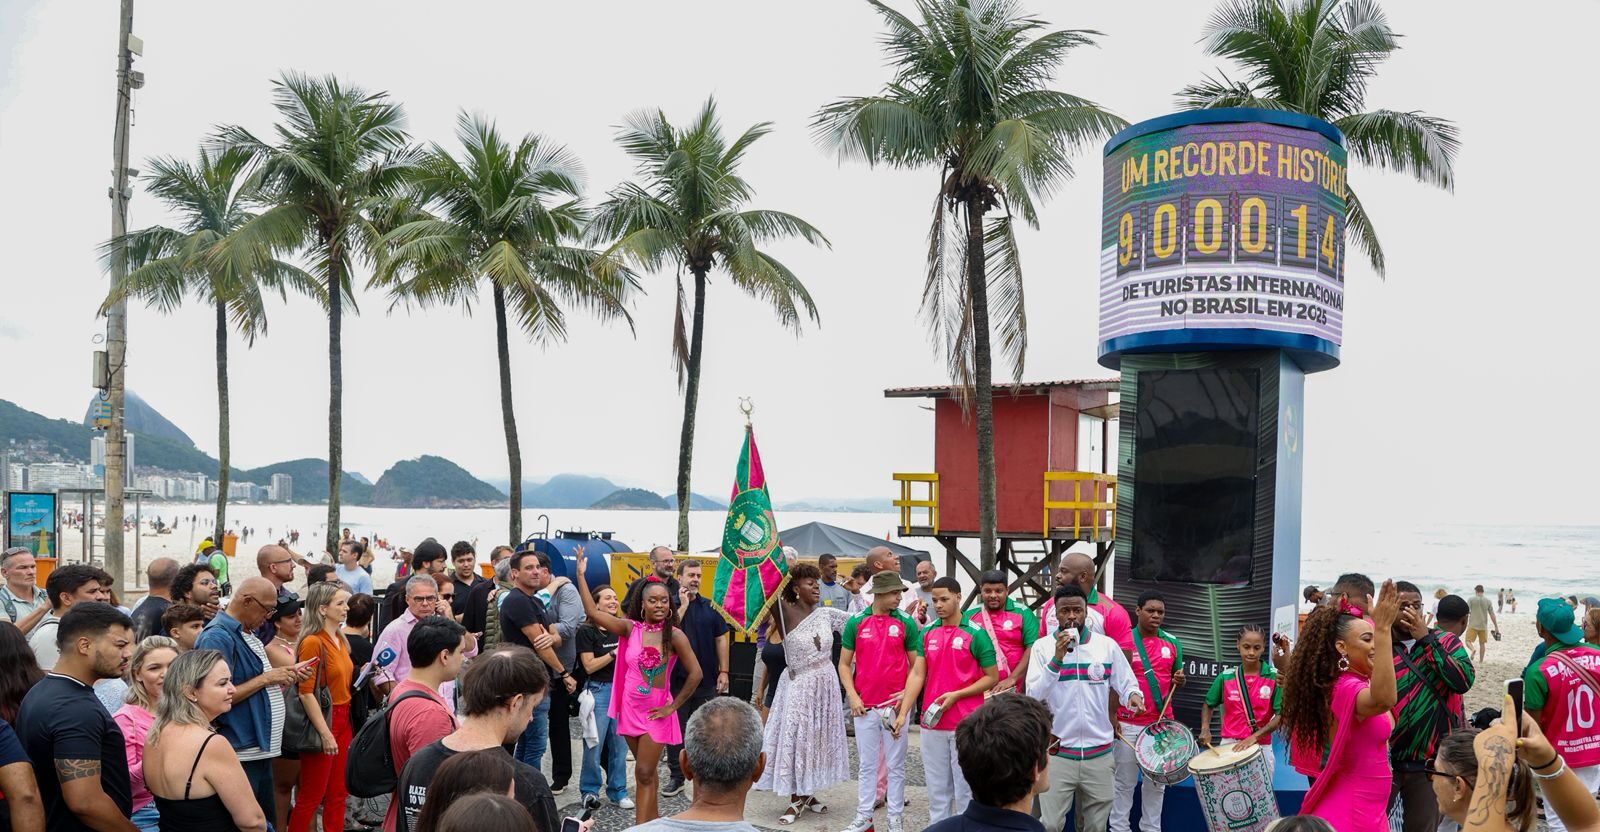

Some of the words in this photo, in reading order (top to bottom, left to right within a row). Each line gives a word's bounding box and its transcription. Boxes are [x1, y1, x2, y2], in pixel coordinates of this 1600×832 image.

[1122, 153, 1148, 193] UM
[1154, 141, 1271, 183] RECORDE
[1122, 283, 1139, 301] DE
[1141, 275, 1232, 297] TURISTAS
[1160, 299, 1188, 317] NO
[1192, 297, 1264, 314] BRASIL
[1267, 299, 1293, 318] EM
[1296, 303, 1327, 325] 2025
[1565, 684, 1595, 733] 10
